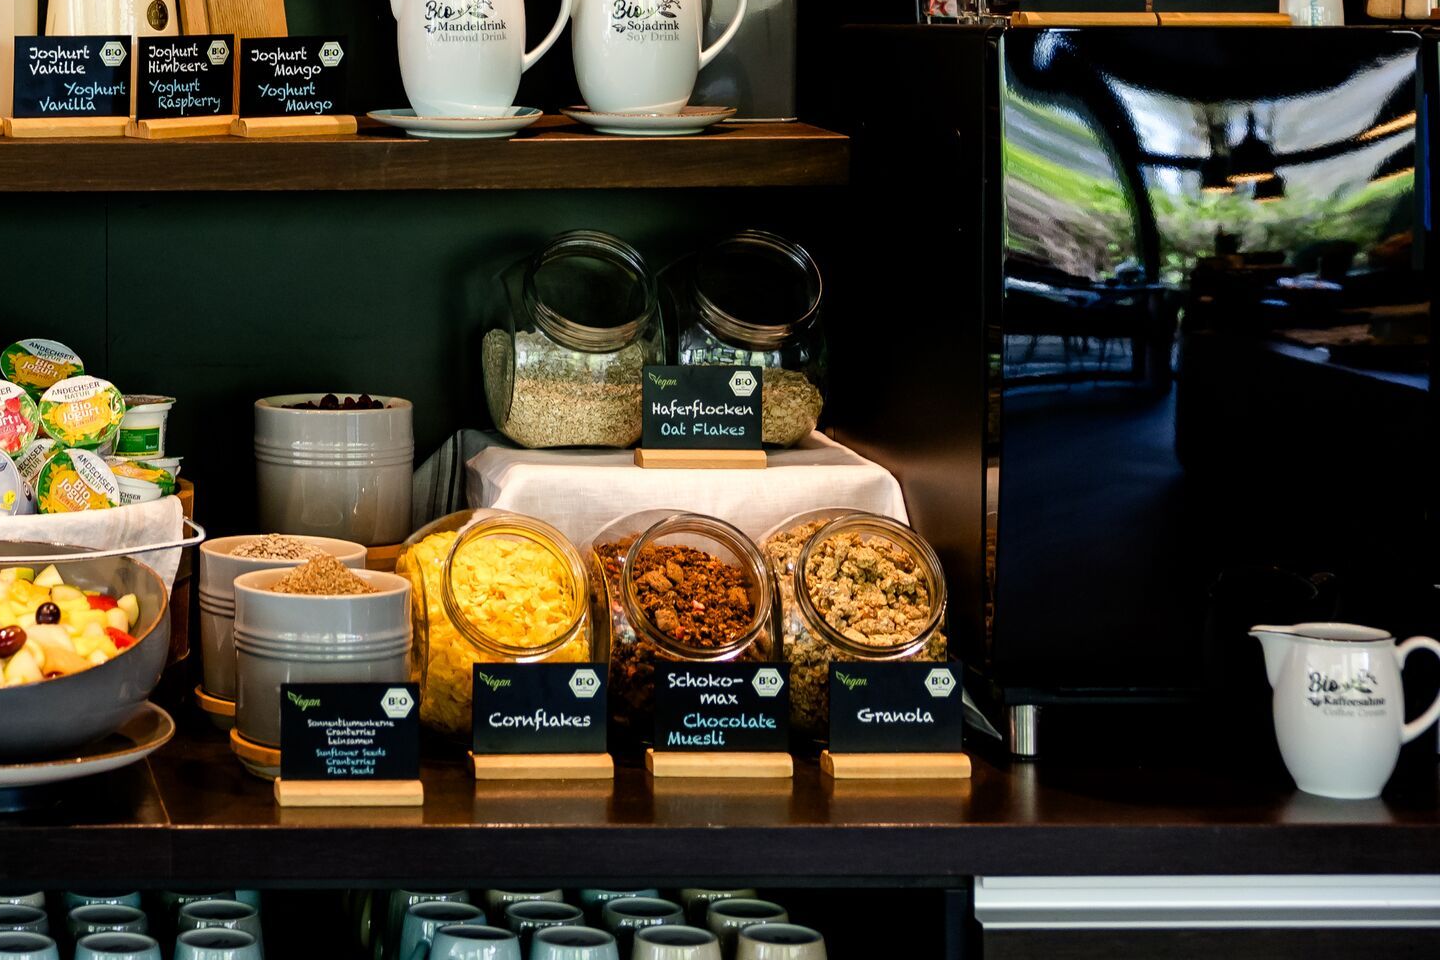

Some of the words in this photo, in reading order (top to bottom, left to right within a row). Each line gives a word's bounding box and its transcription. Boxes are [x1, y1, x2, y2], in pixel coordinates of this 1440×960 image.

[425, 0, 455, 21] Bio
[612, 0, 644, 20] Bio
[437, 19, 507, 32] Mandeldrink
[627, 19, 680, 32] Sojadrink
[437, 32, 479, 43] Almond
[481, 31, 507, 41] Drink
[626, 31, 647, 43] Soy
[650, 31, 680, 41] Drink
[29, 45, 90, 63] Joghurt
[148, 43, 199, 62] Joghurt
[251, 46, 308, 66] Joghurt
[30, 63, 86, 75] Vanille
[148, 60, 208, 73] Himbeere
[274, 64, 322, 80] Mango
[63, 81, 126, 99] Yoghurt
[149, 78, 200, 97] Yoghurt
[258, 81, 316, 101] Yoghurt
[39, 98, 96, 111] Vanilla
[158, 95, 221, 115] Raspberry
[285, 98, 333, 115] Mango
[29, 341, 75, 361] ANDECHSER
[51, 381, 101, 396] ANDECHSER
[650, 374, 677, 390] Vegan
[62, 407, 100, 422] Jogurt
[70, 401, 92, 411] Bio
[652, 399, 753, 419] Haferflocken
[661, 422, 686, 436] Oat
[693, 422, 745, 436] Flakes
[77, 453, 115, 494] ANDECHSER
[482, 672, 511, 691] Vegan
[668, 672, 744, 689] Schoko-
[838, 672, 868, 690] Vegan
[1308, 671, 1339, 692] Bio
[289, 692, 321, 711] Vegan
[699, 692, 738, 705] max
[488, 709, 591, 731] Cornflakes
[683, 713, 777, 729] Chocolate
[857, 708, 934, 723] Granola
[667, 730, 725, 746] Muesli
[315, 748, 359, 758] Sunflower
